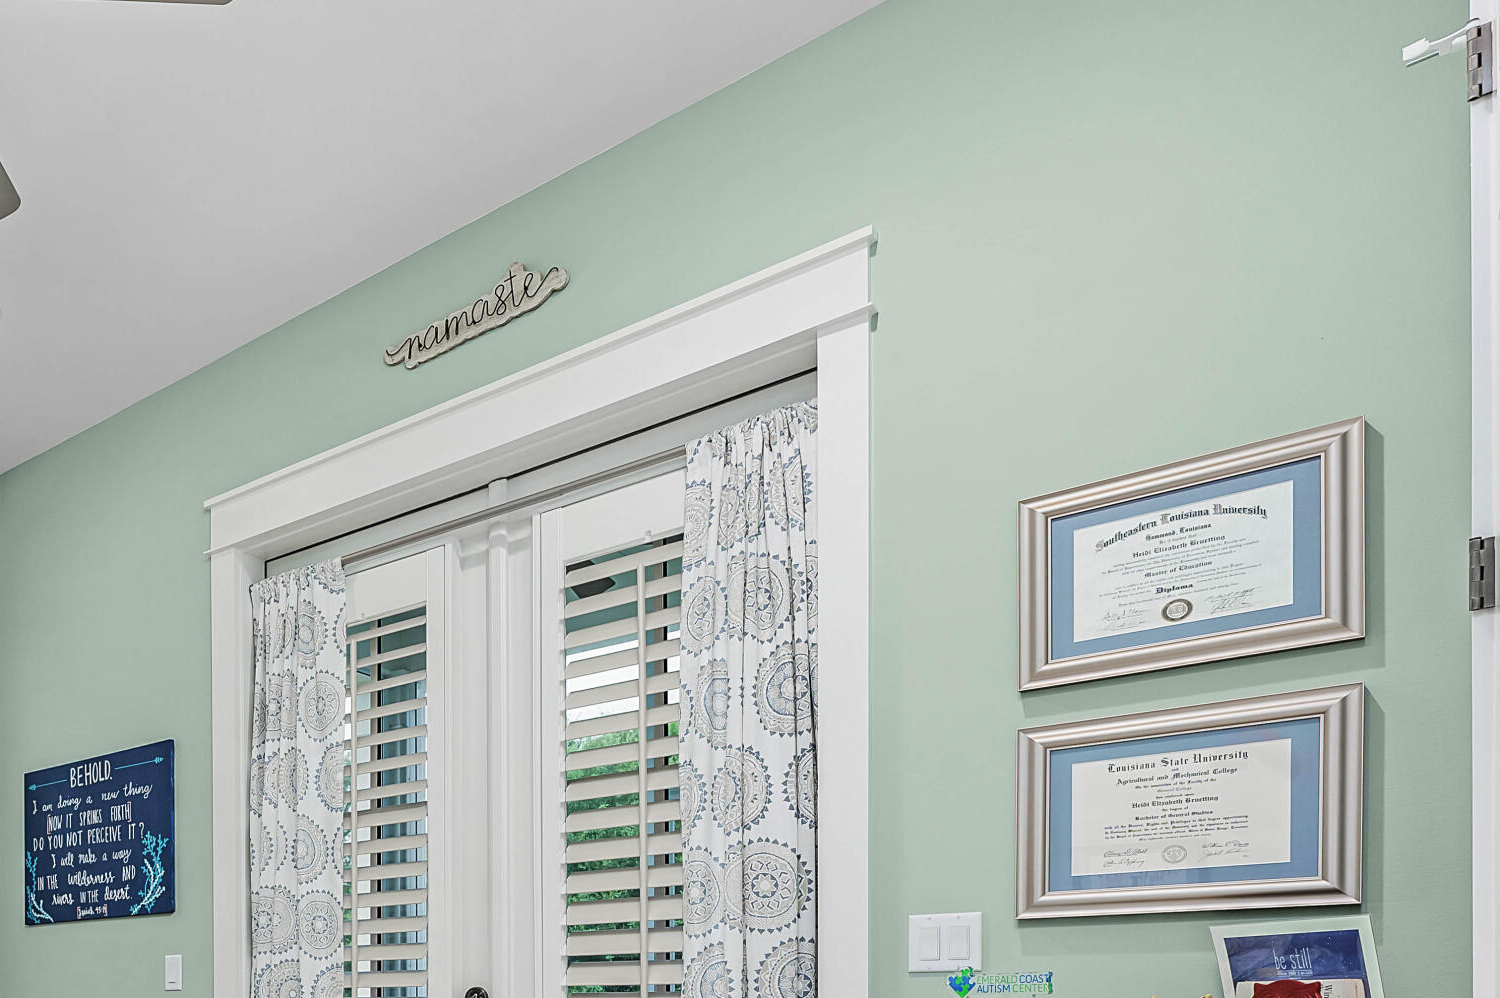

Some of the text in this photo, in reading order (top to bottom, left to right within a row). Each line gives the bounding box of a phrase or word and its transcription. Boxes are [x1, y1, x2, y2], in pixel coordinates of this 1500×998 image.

[386, 267, 558, 359] namaste
[1095, 520, 1157, 553] Southeastern
[1160, 509, 1209, 524] Louisiana
[1213, 503, 1268, 519] University
[1155, 583, 1193, 594] Diploma
[1108, 751, 1248, 773] Louisiana State University
[1116, 775, 1154, 786] Agricultural
[1171, 770, 1209, 780] Mechanical
[1212, 767, 1238, 775] College
[32, 800, 37, 815] I
[57, 794, 81, 810] doing
[86, 795, 93, 804] a
[123, 781, 153, 799] thing
[66, 813, 73, 829] IT
[79, 808, 103, 827] SPRINGS
[33, 837, 45, 852] DO
[47, 834, 64, 850] YOU
[66, 830, 83, 847] NOT
[87, 825, 122, 845] PERCEIVE
[51, 848, 132, 868] I will make a way
[37, 865, 136, 891] IN THE wilderness AND
[1273, 947, 1313, 970] be still
[976, 974, 1049, 984] EMERALD COAST
[976, 984, 1049, 993] AUTISM CENTER
